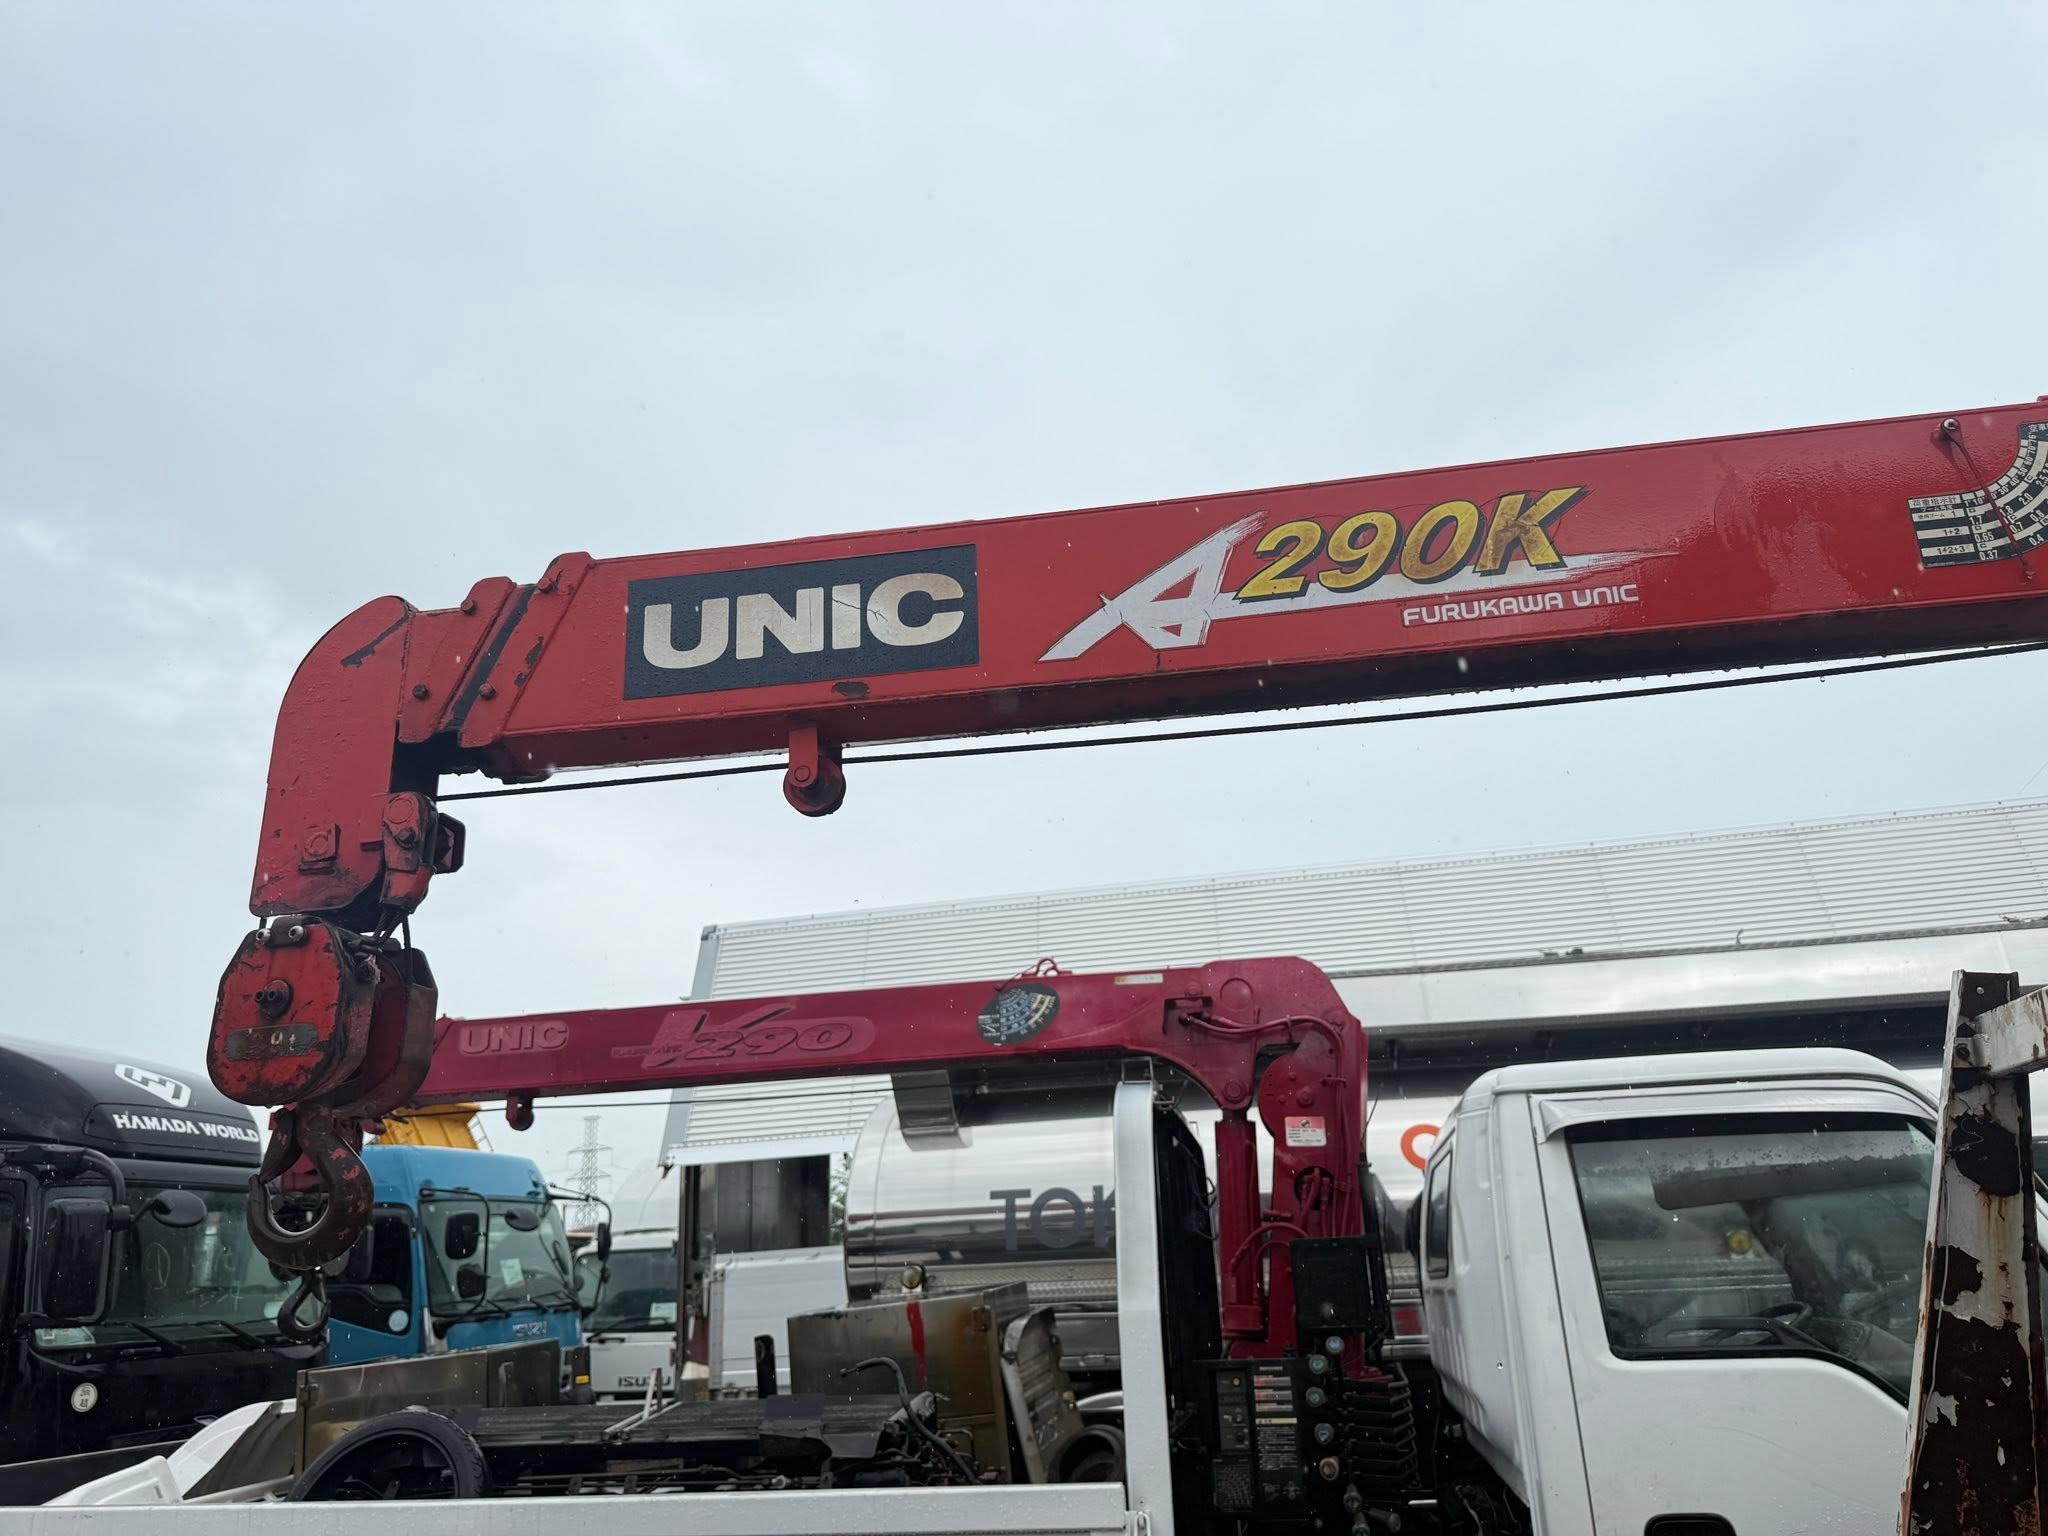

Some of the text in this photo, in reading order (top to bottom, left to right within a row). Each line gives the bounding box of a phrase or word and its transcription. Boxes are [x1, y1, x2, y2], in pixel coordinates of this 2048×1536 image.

[1979, 549, 1999, 561] 0.37
[642, 572, 965, 670] UNIC
[1403, 584, 1639, 626] FURUKAWA UNIC
[461, 1022, 568, 1055] UNIC
[112, 1114, 260, 1143] HAMADA WORLD
